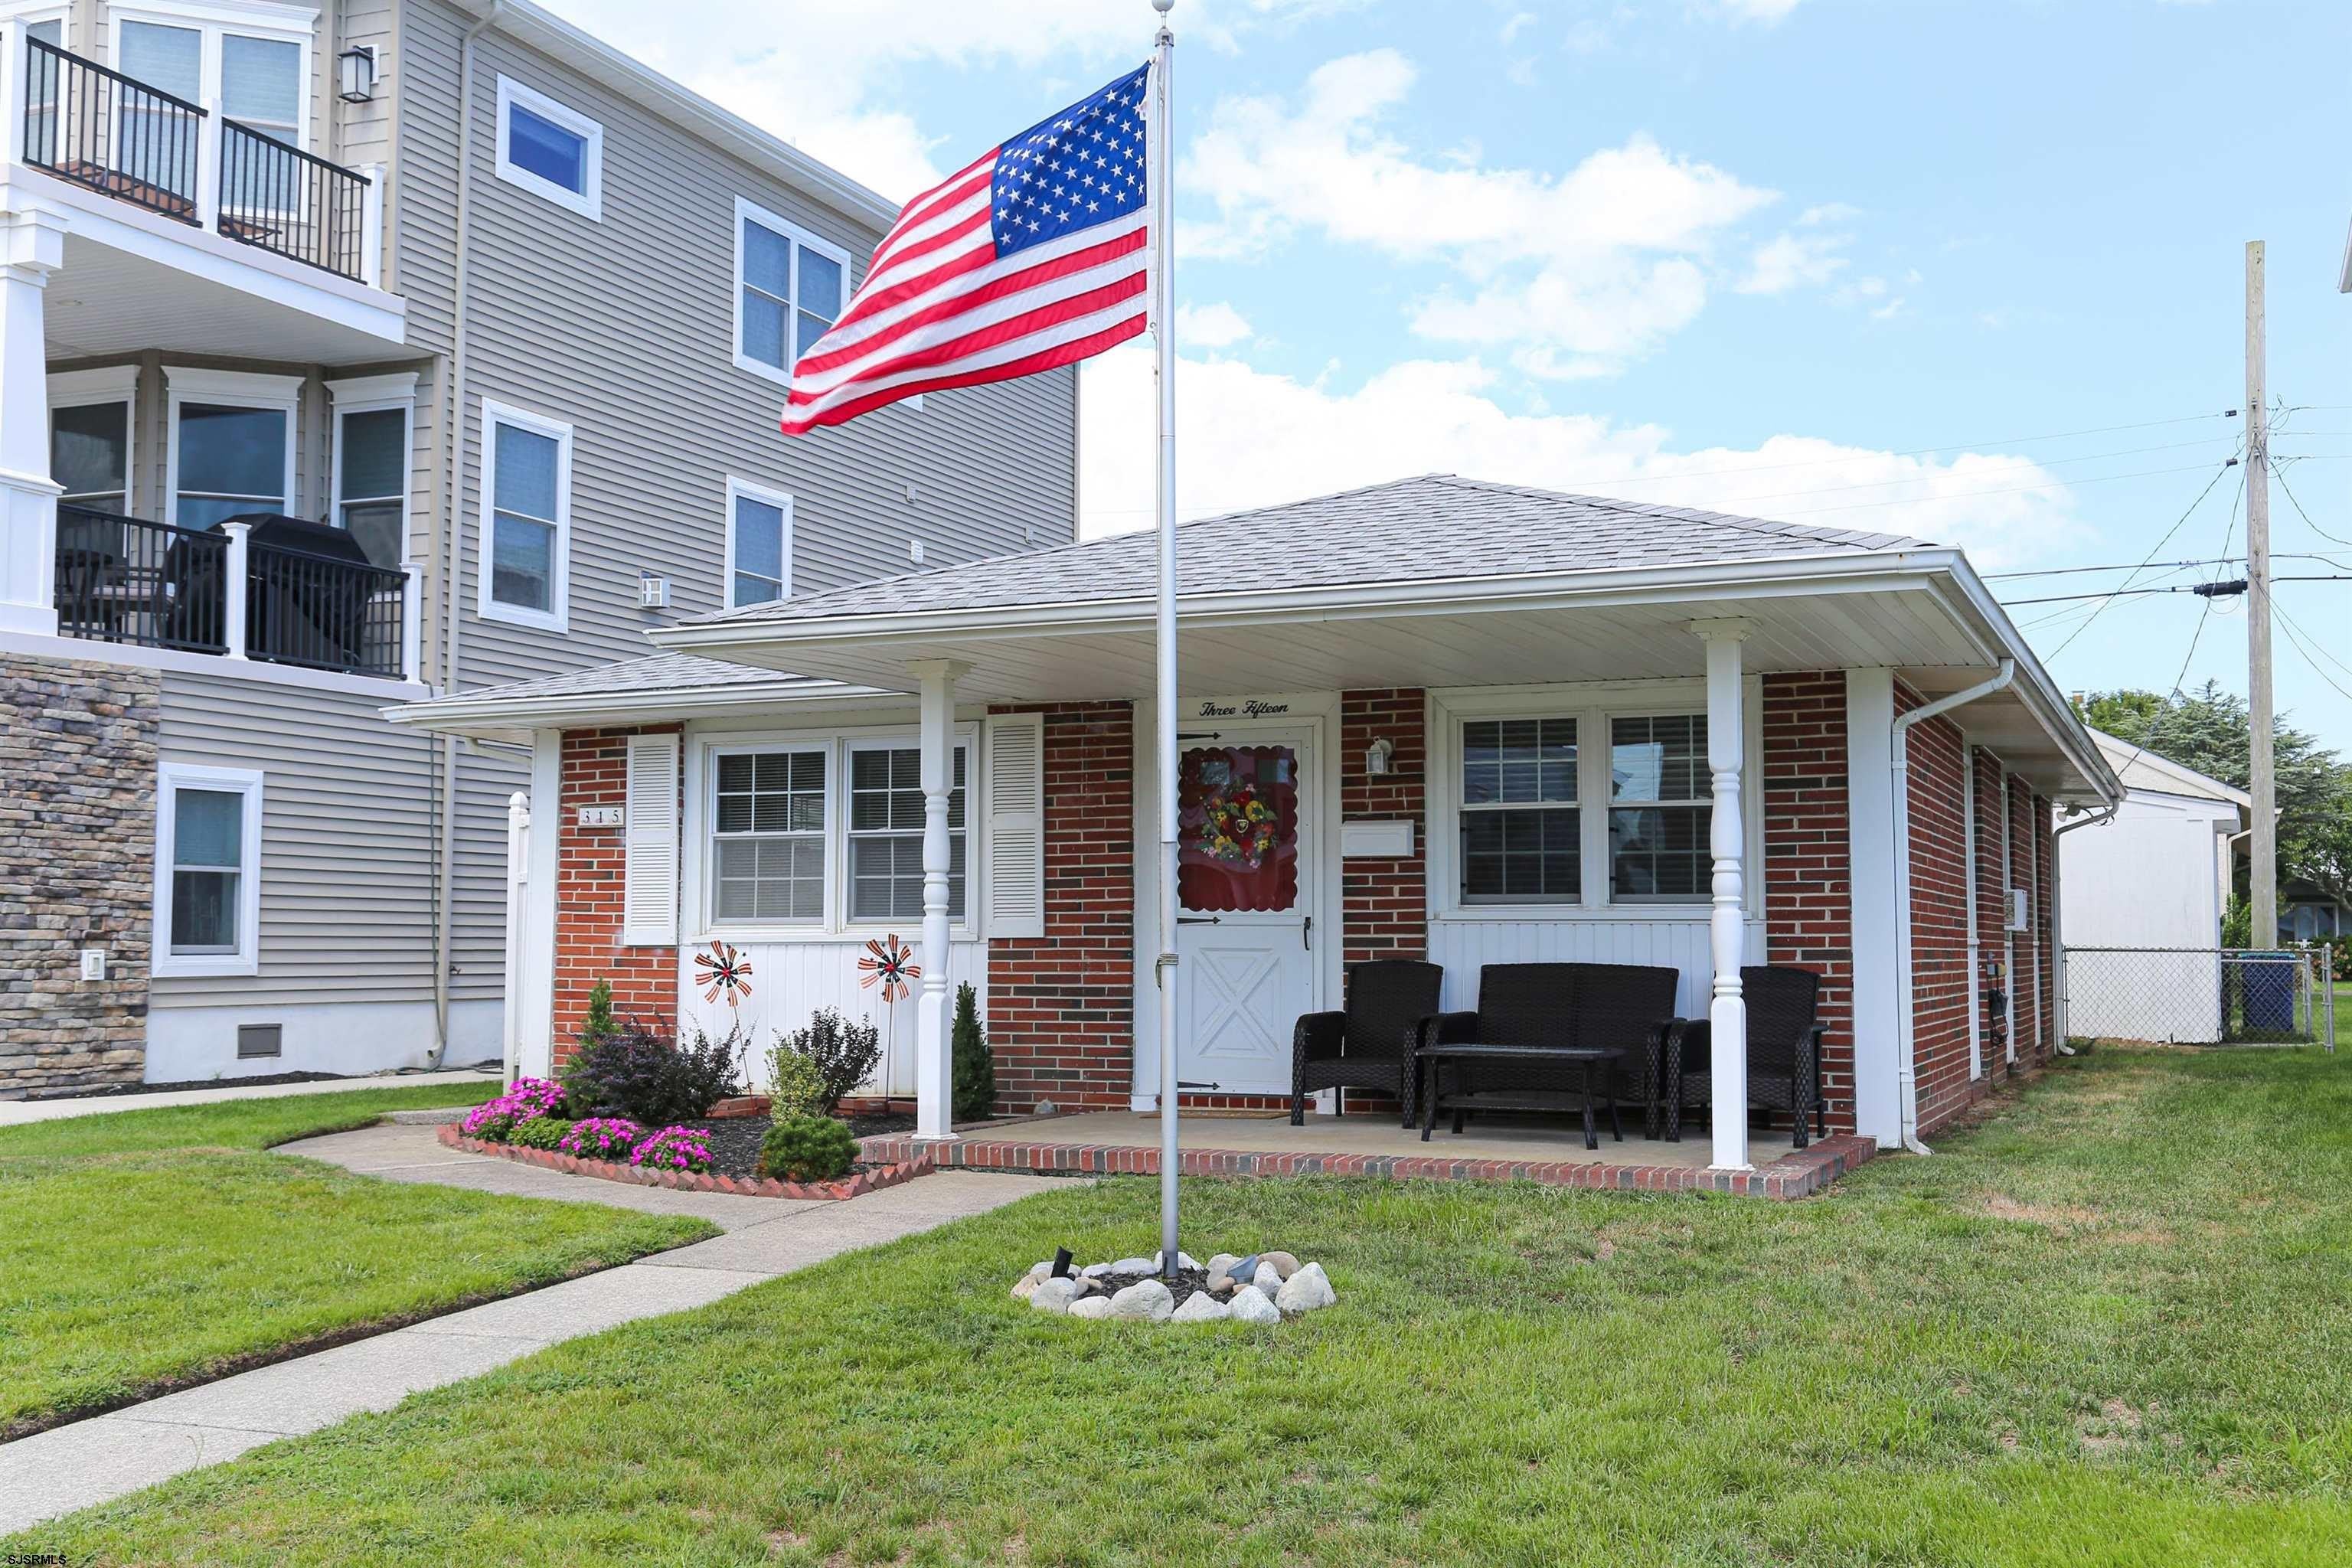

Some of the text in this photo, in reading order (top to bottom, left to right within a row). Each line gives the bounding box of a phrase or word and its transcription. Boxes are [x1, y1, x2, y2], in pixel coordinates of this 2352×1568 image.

[1199, 700, 1289, 719] Three Fifteen
[582, 809, 619, 824] 315
